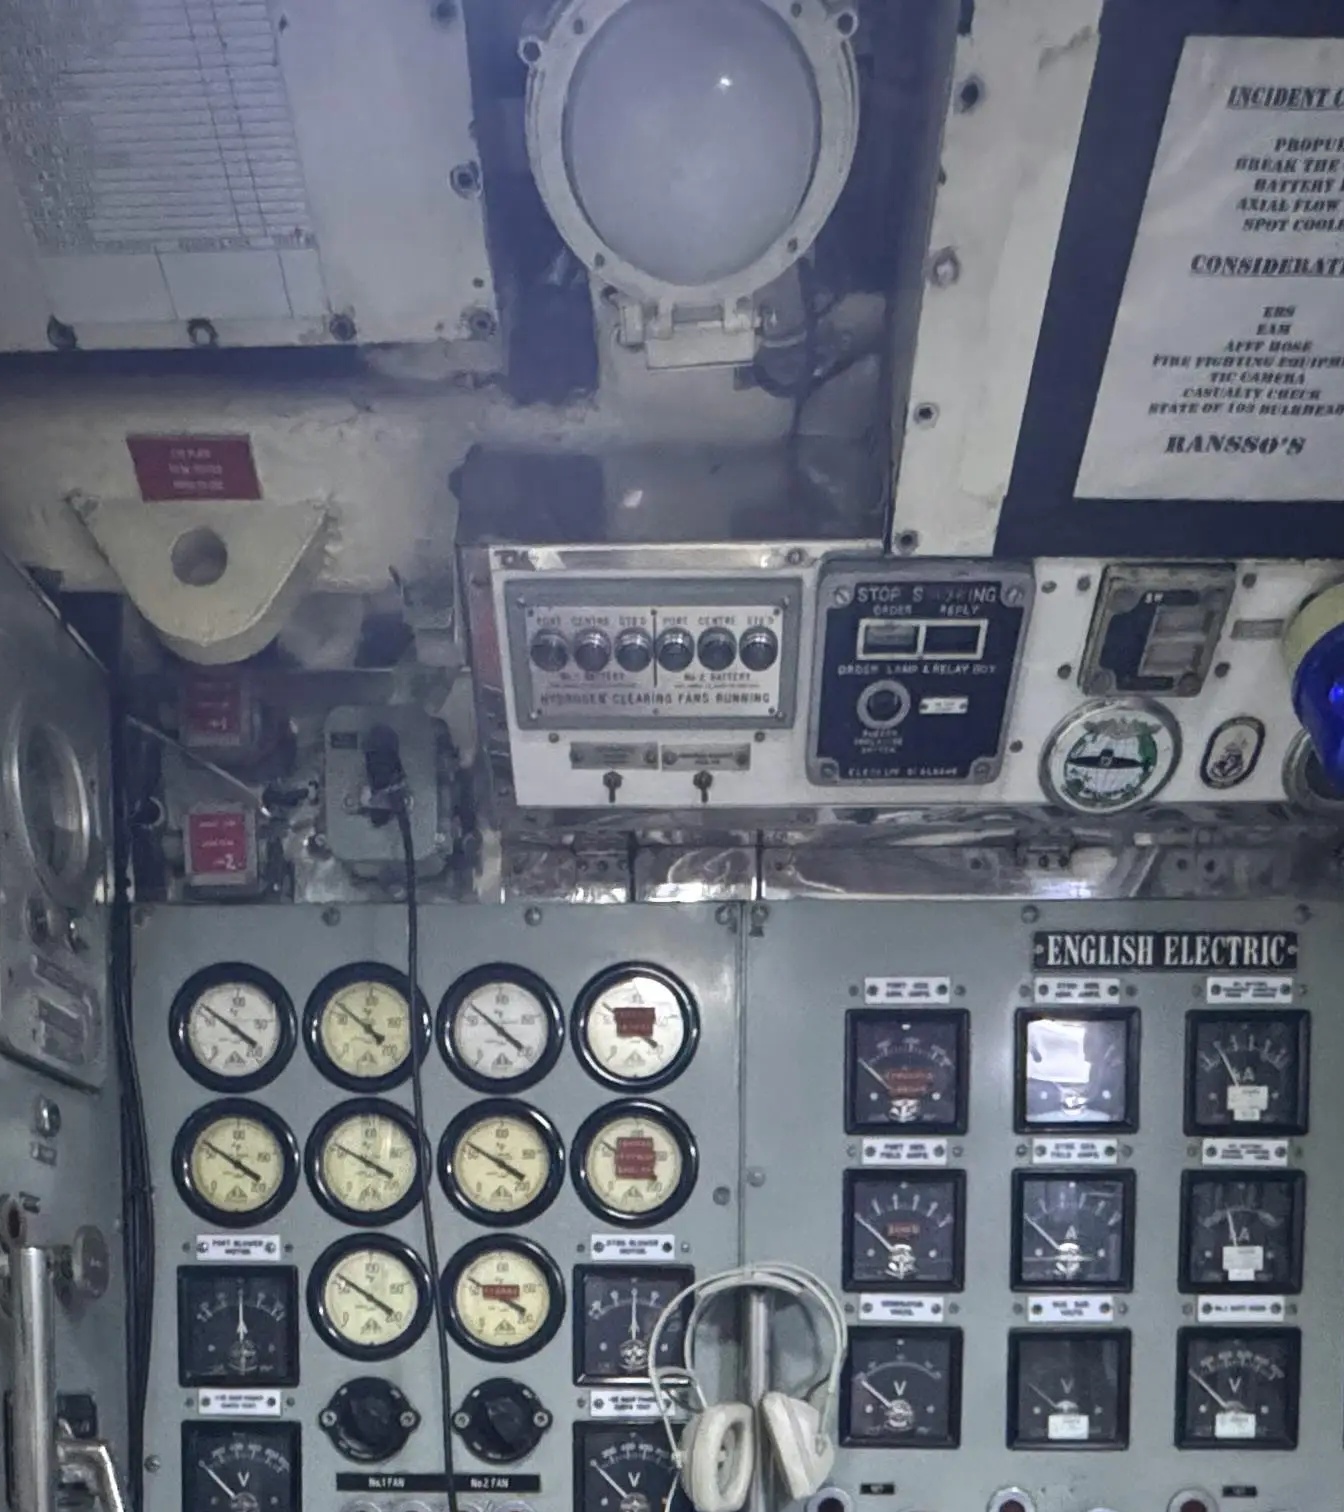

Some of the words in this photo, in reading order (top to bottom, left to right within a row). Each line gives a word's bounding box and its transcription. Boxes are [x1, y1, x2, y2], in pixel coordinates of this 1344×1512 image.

[1226, 85, 1330, 108] INCIDENT
[1234, 157, 1298, 171] BREAK
[1303, 158, 1340, 173] THE
[1254, 178, 1335, 193] BATTERY
[1236, 198, 1290, 212] AXIAL
[1292, 199, 1343, 213] FLOW
[1242, 219, 1290, 232] SPOT
[858, 587, 901, 602] STOP
[1046, 935, 1154, 967] ENGLISH
[1164, 934, 1286, 965] ELECTRIC
[237, 1471, 250, 1488] V
[388, 1477, 405, 1488] FAN
[490, 1478, 509, 1488] FAN
[627, 1472, 641, 1487] V
